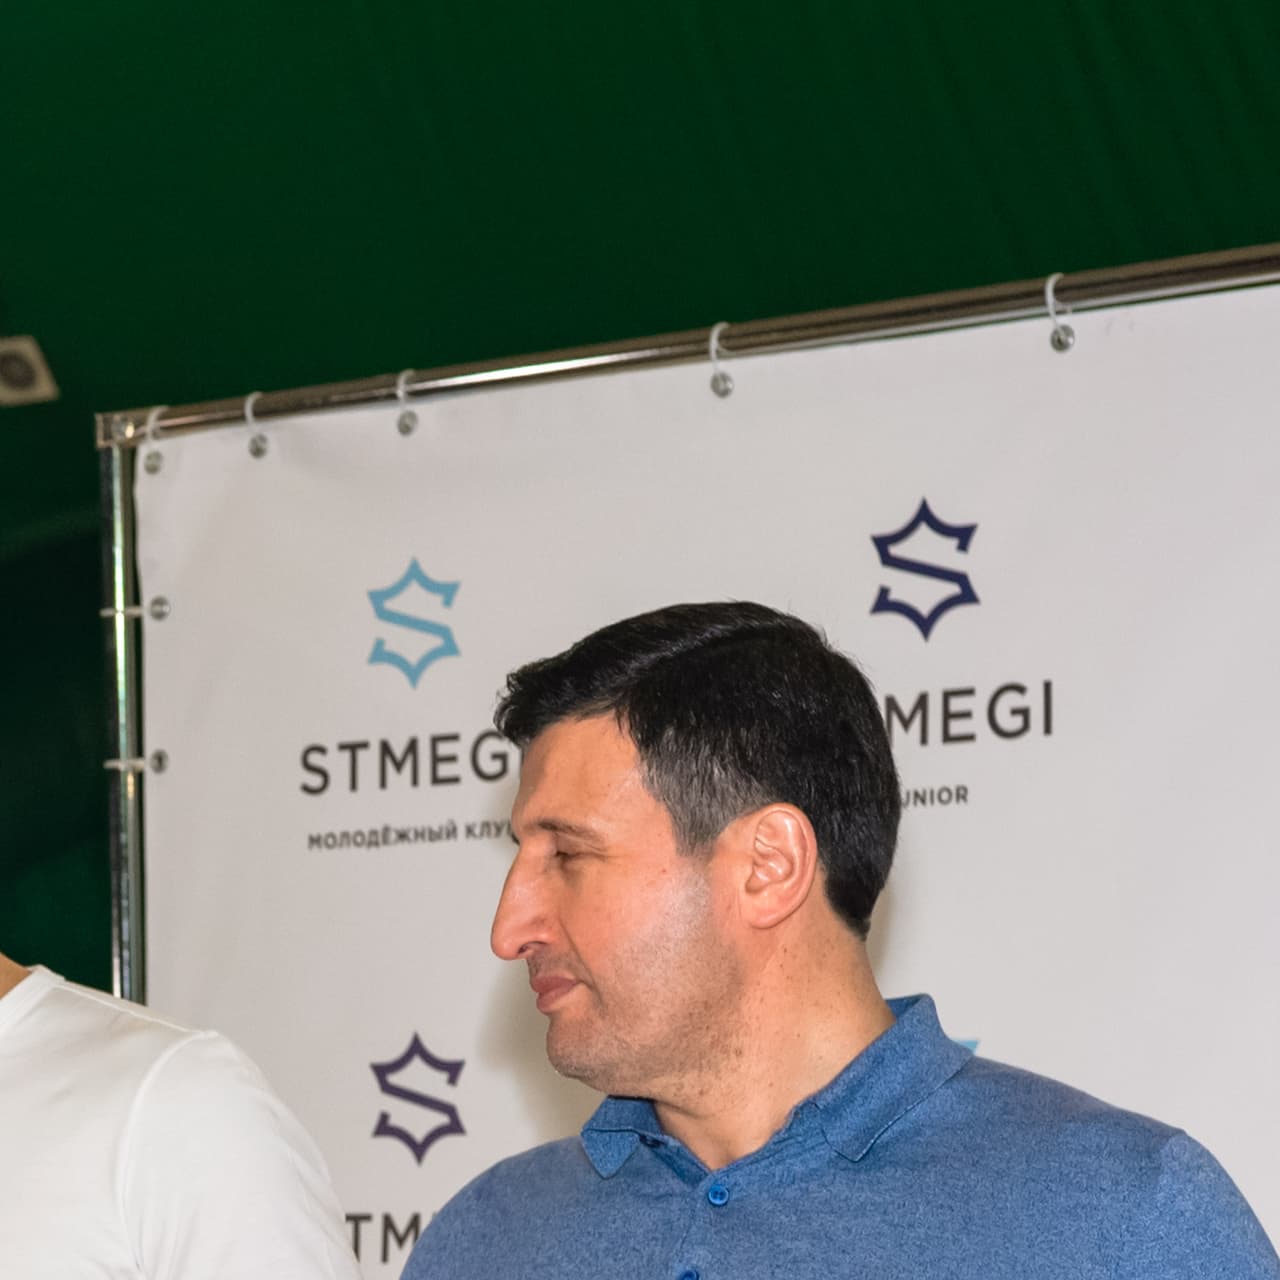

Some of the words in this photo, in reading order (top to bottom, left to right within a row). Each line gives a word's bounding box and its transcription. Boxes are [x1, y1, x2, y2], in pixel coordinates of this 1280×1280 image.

[884, 680, 1053, 748] MEGI
[300, 728, 511, 796] STMEG
[900, 785, 969, 808] UNIOR
[307, 819, 458, 850] МОЛОДЁЖНЫЙ
[465, 820, 514, 841] КЛУ
